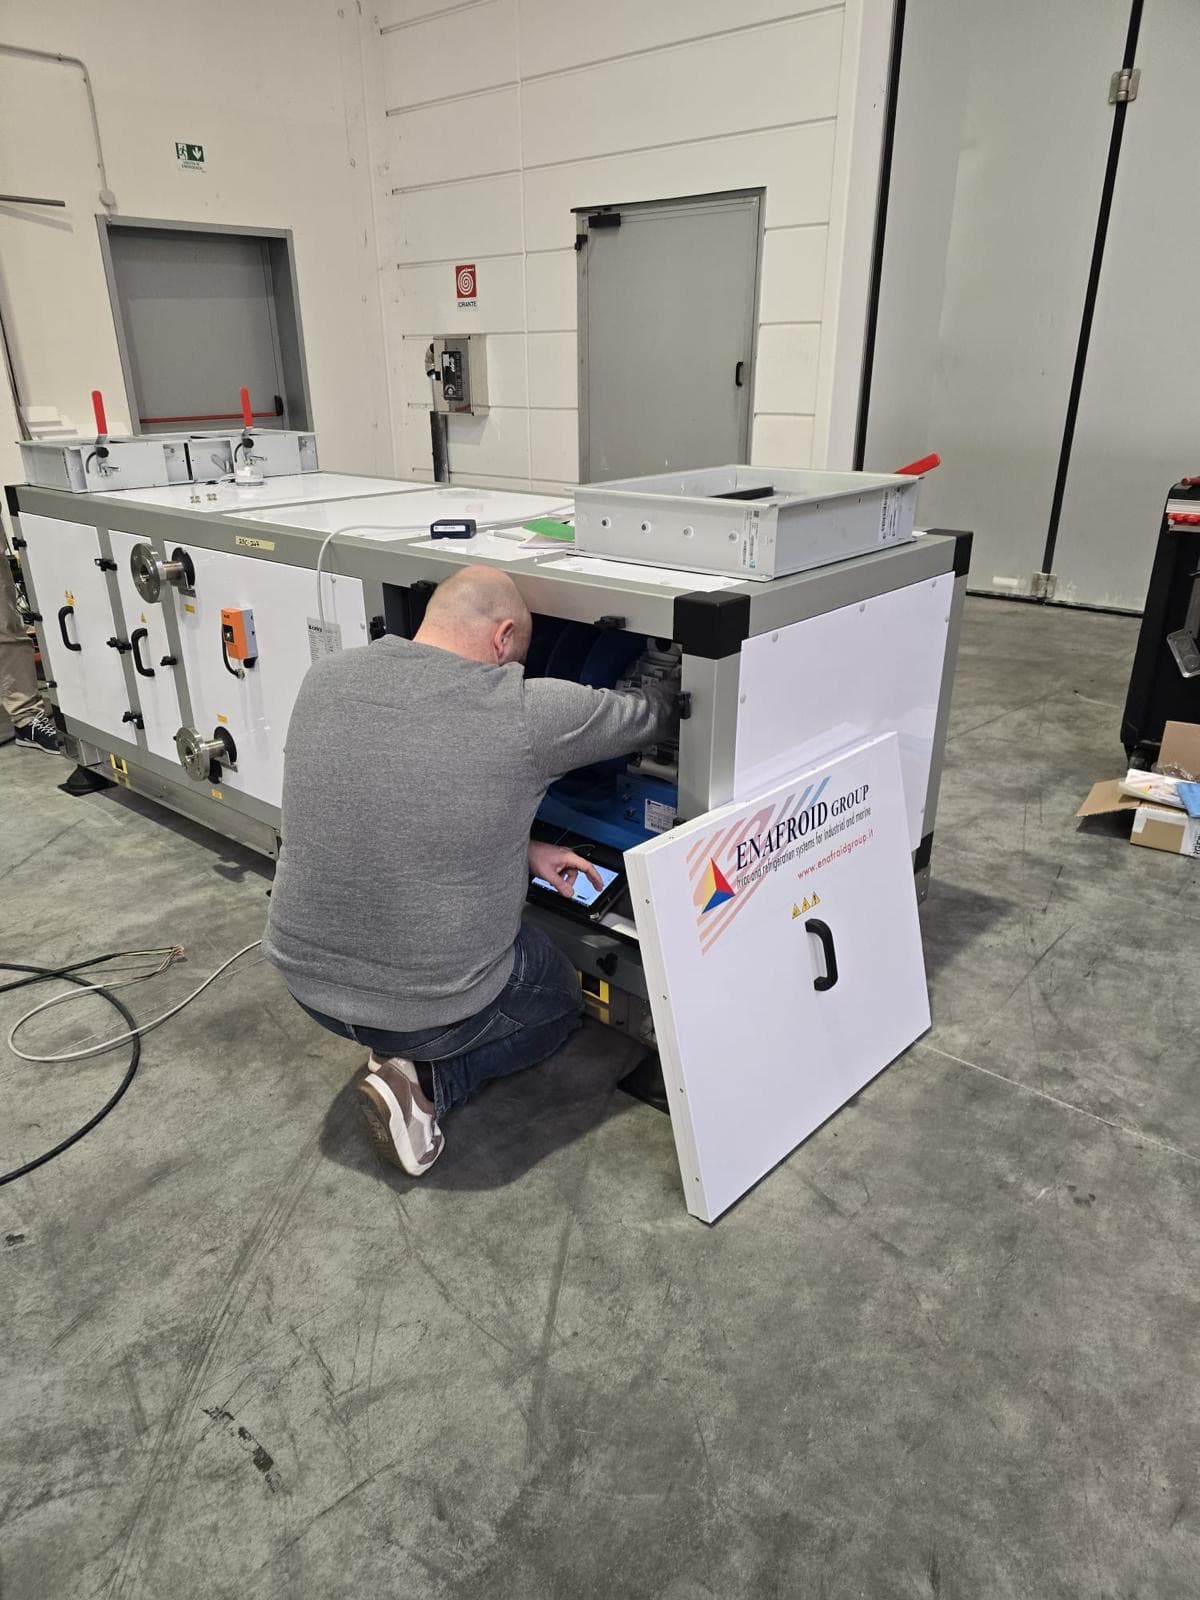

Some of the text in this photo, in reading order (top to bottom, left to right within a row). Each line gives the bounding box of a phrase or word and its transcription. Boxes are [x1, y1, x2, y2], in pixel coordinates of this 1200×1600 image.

[736, 801, 829, 871] ENAFROID
[831, 784, 870, 817] GROUP
[763, 850, 795, 875] refrigeration
[796, 839, 815, 858] systems
[824, 818, 846, 840] industrial
[846, 811, 855, 828] and
[855, 807, 871, 822] marine
[797, 828, 874, 880] www.enafroidgroup.it
